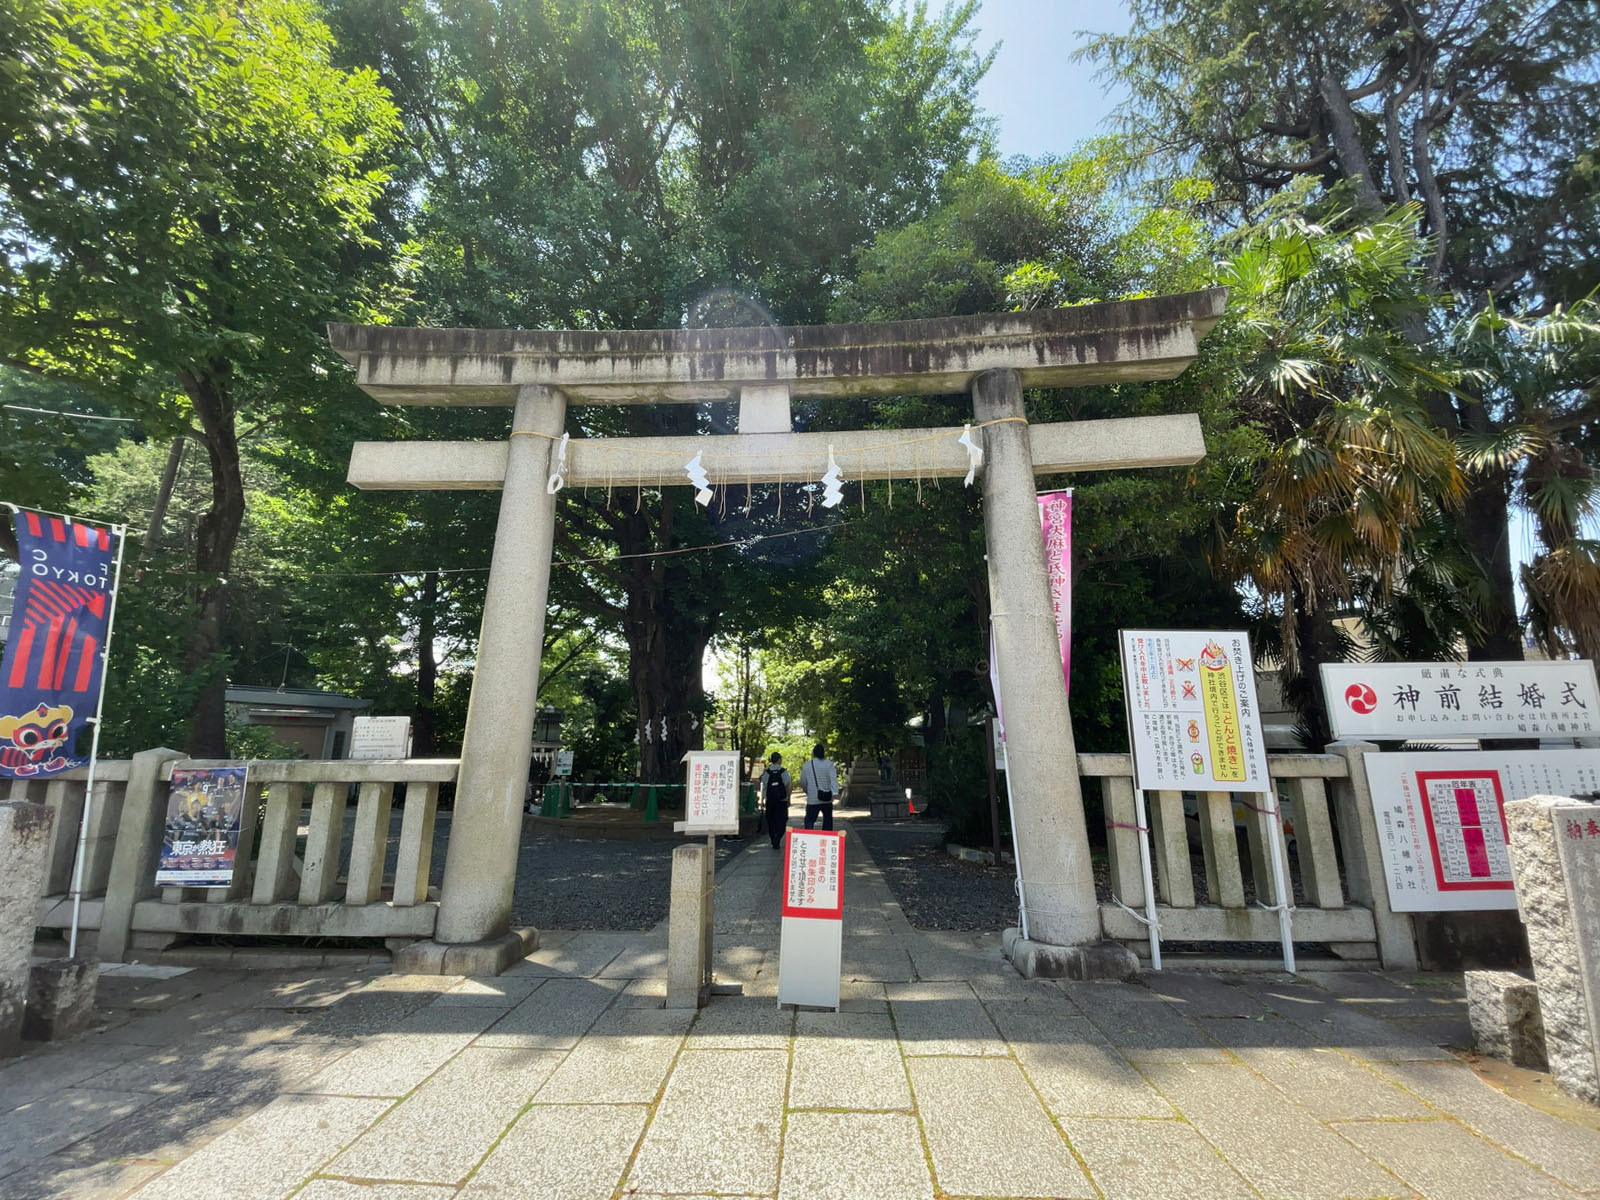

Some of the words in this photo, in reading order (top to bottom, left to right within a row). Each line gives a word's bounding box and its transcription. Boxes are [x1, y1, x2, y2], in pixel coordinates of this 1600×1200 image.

[1231, 639, 1251, 718] お焚き上げのご案内
[1420, 667, 1505, 680] 厳粛な式典
[1391, 681, 1587, 712] 神前結婚式
[1207, 672, 1228, 778] 神社境内で行うことができません
[710, 771, 719, 796] おりて
[718, 764, 727, 801] 自転車から
[797, 840, 807, 906] とさせて頂きます
[806, 858, 817, 904] 御朱印のみ
